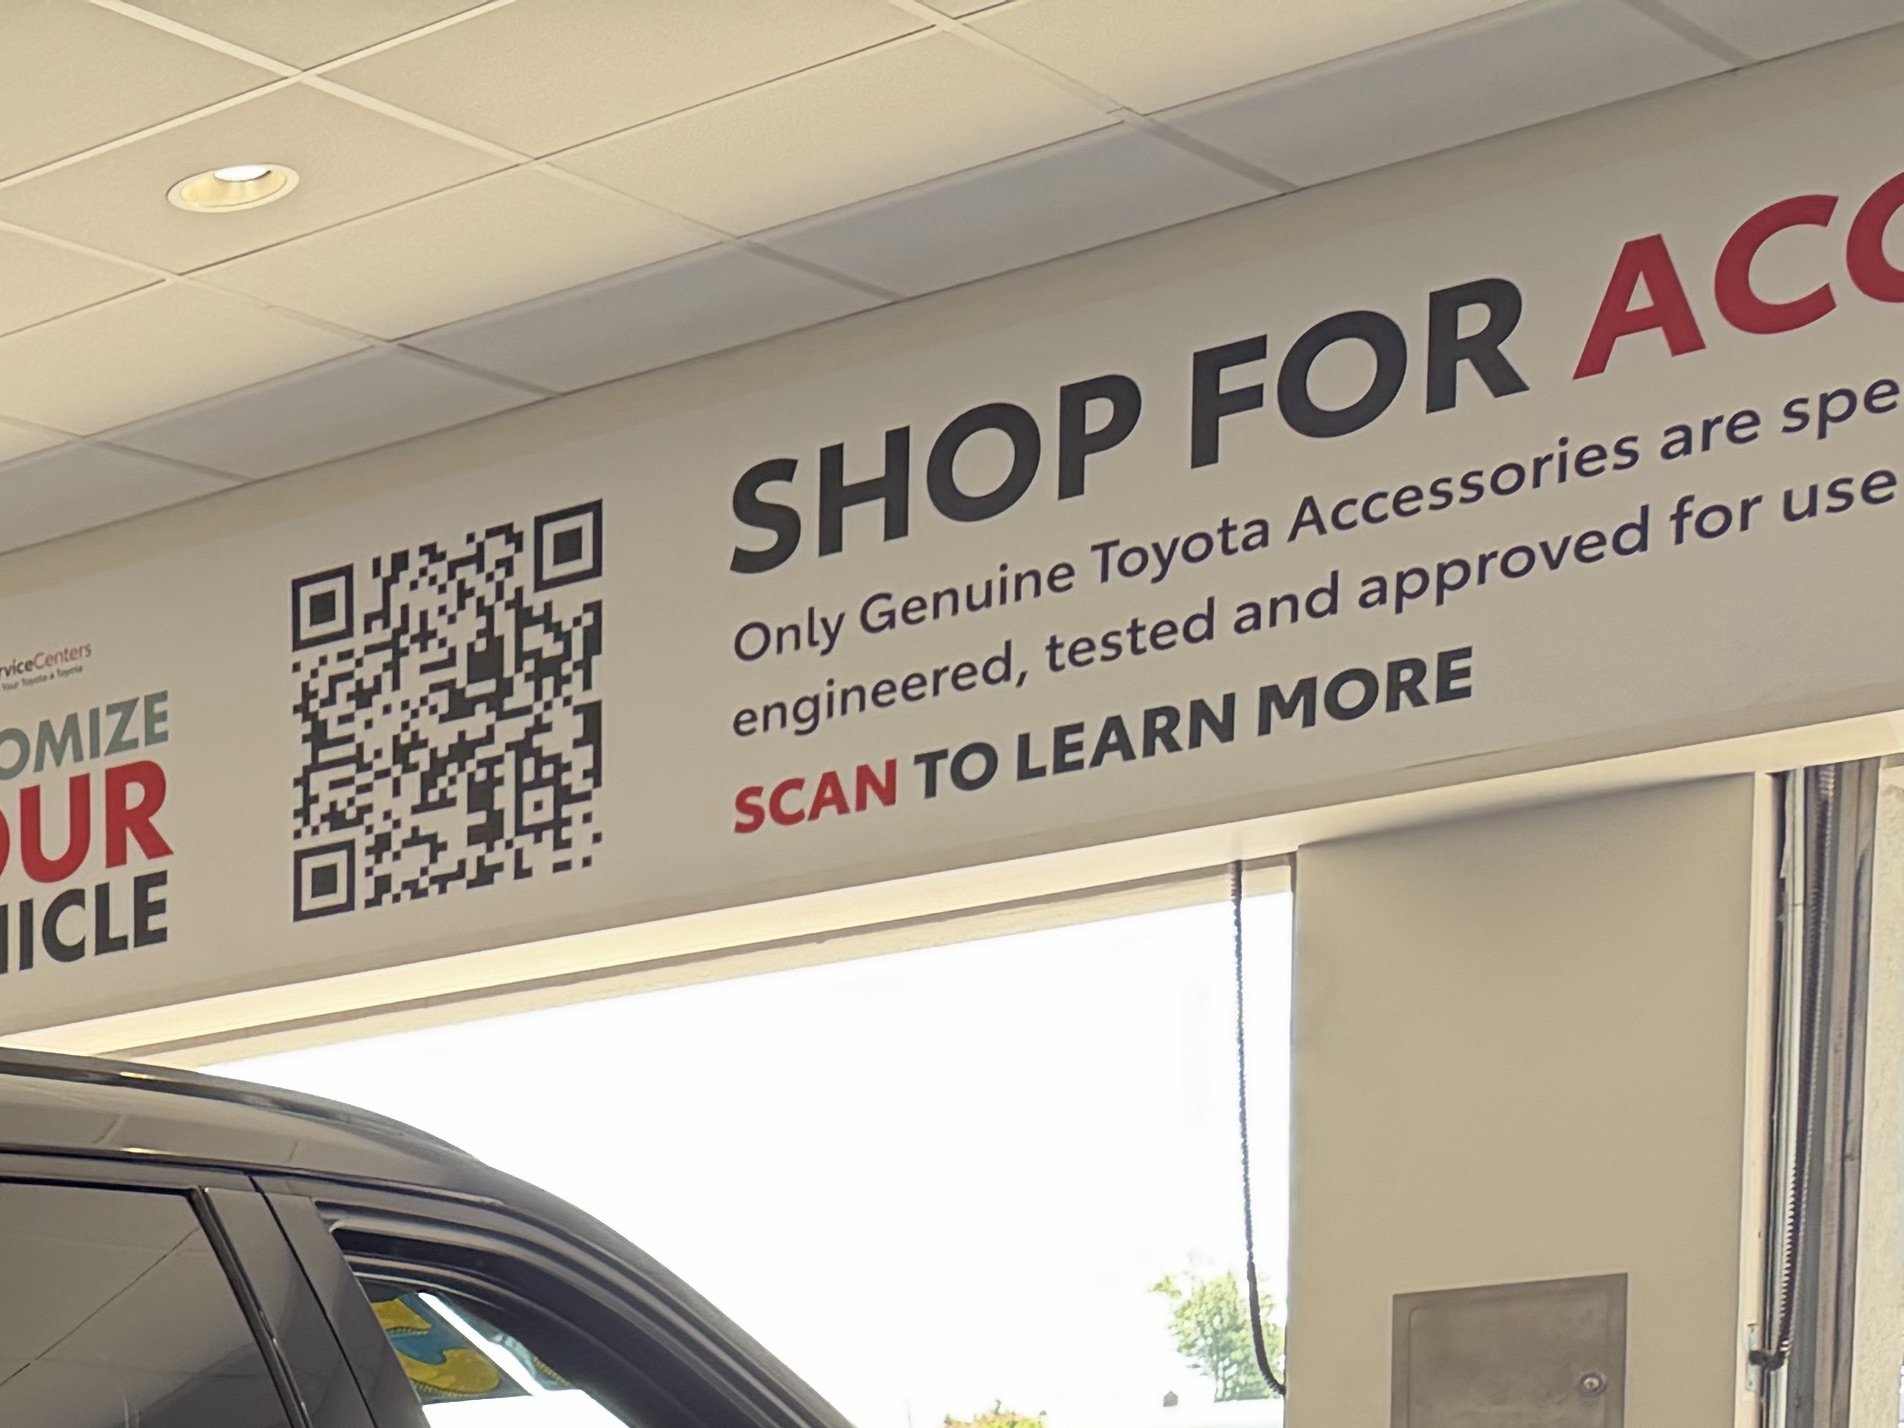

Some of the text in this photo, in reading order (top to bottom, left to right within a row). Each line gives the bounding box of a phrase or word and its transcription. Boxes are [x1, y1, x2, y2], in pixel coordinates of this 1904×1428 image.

[730, 374, 1143, 575] SHOP
[1190, 277, 1530, 470] FOR
[733, 606, 845, 662] Only
[859, 561, 1075, 634] Genuine
[1090, 517, 1270, 585] Toyota
[1287, 436, 1640, 543] Accessories
[1660, 408, 1761, 461] are
[2, 680, 20, 692] Your
[733, 469, 1898, 737] engineered, tested and approved for use
[733, 646, 1473, 834] SCAN TO LEARN MORE
